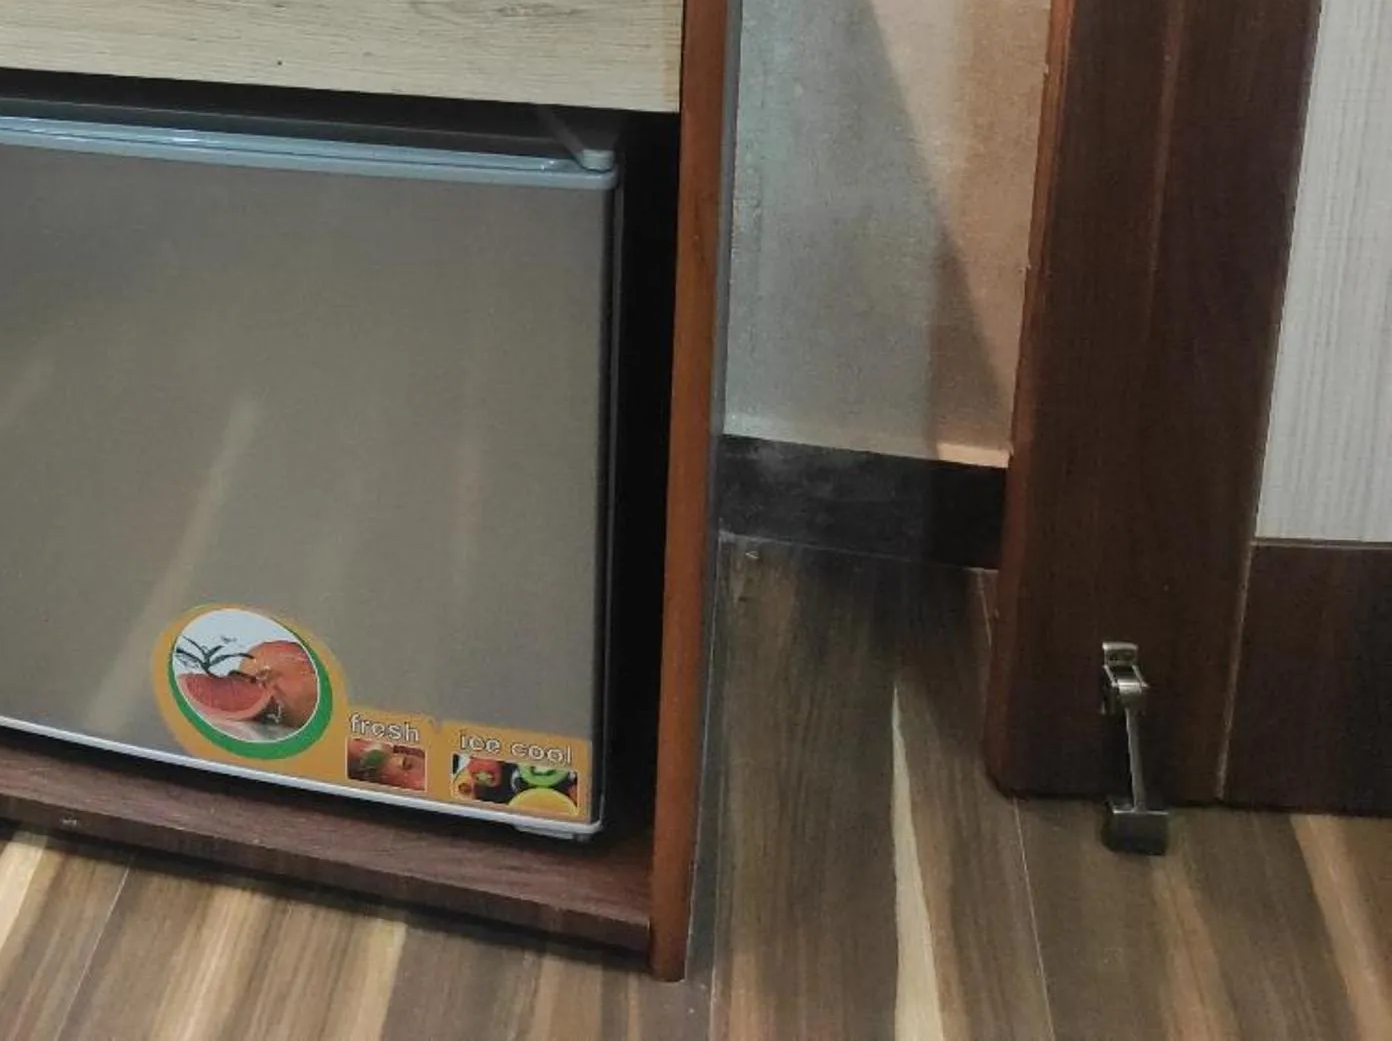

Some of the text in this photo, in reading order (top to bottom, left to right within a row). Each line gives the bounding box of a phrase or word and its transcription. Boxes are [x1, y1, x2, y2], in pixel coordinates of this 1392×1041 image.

[350, 713, 419, 742] fresh
[460, 732, 572, 765] ice cool
